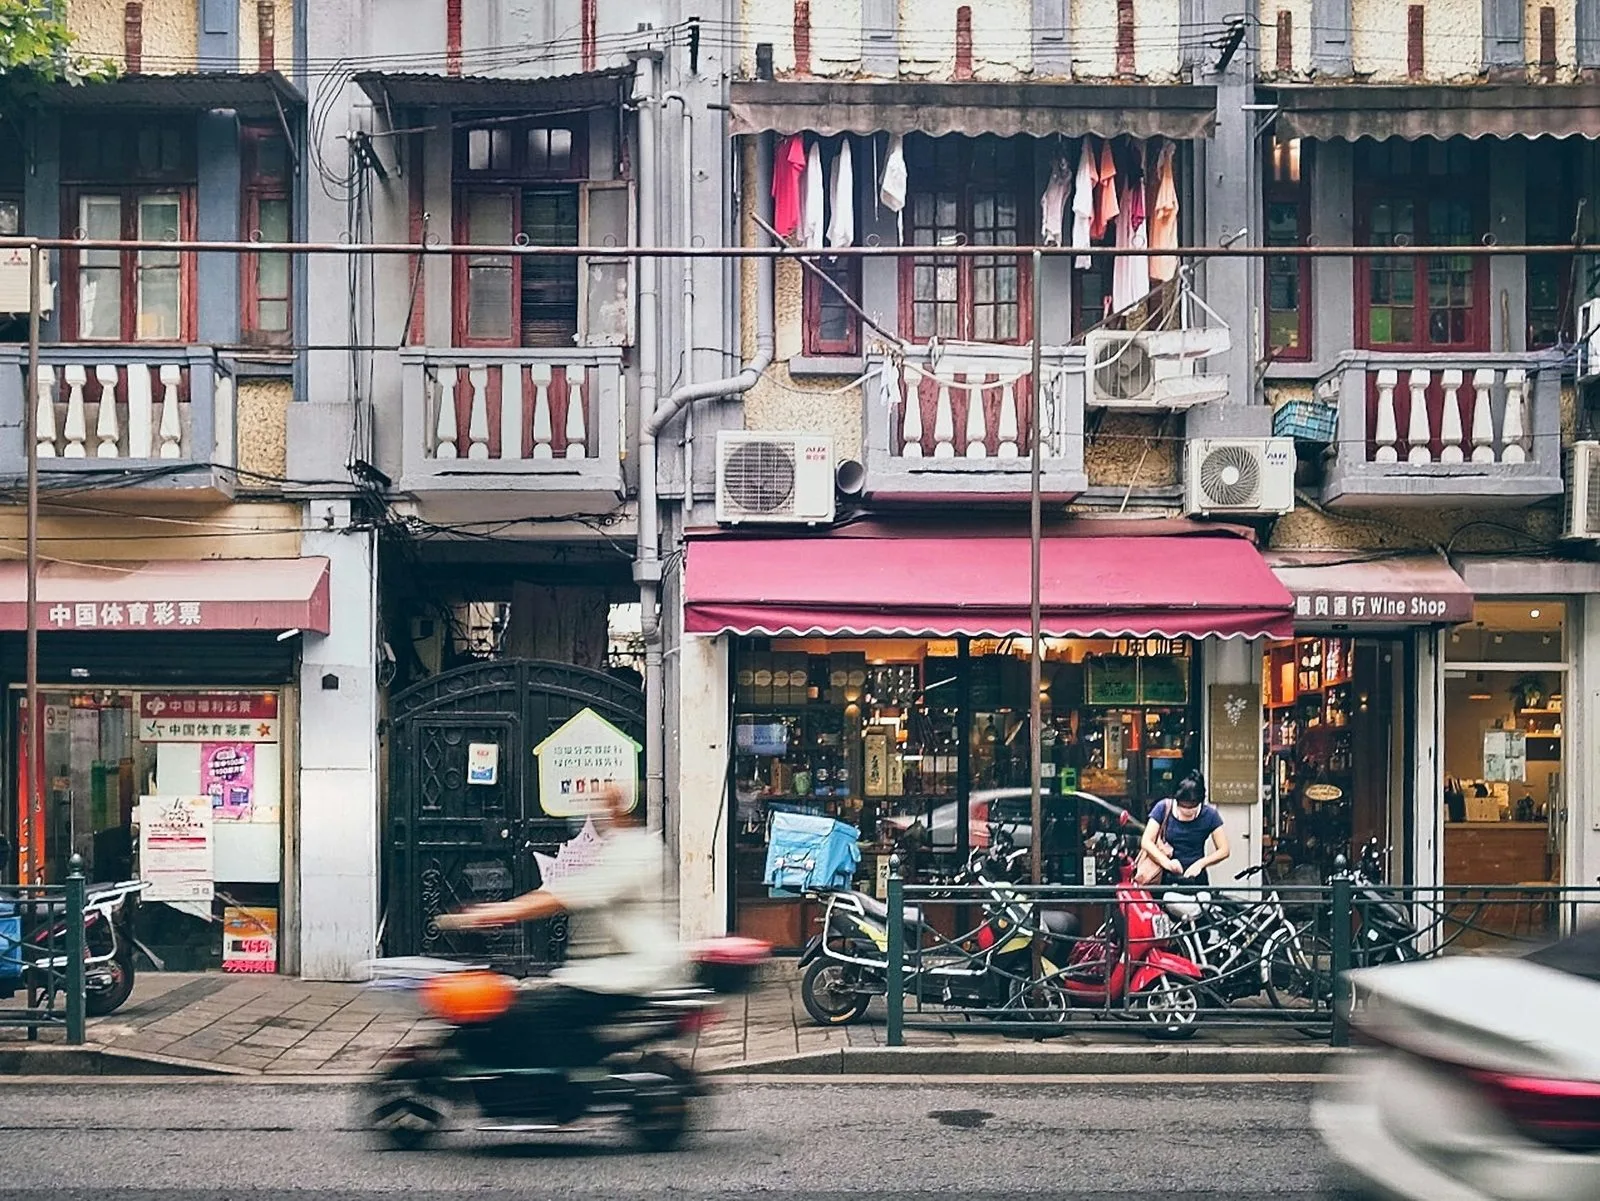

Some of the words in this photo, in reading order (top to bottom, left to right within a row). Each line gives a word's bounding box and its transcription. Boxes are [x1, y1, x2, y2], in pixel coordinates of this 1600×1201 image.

[49, 602, 201, 626] 中国体育彩票
[1370, 597, 1406, 616] Wine
[1411, 597, 1446, 616] Shop
[169, 700, 251, 713] 中国福利彩票
[169, 724, 251, 737] 中国体育彩票
